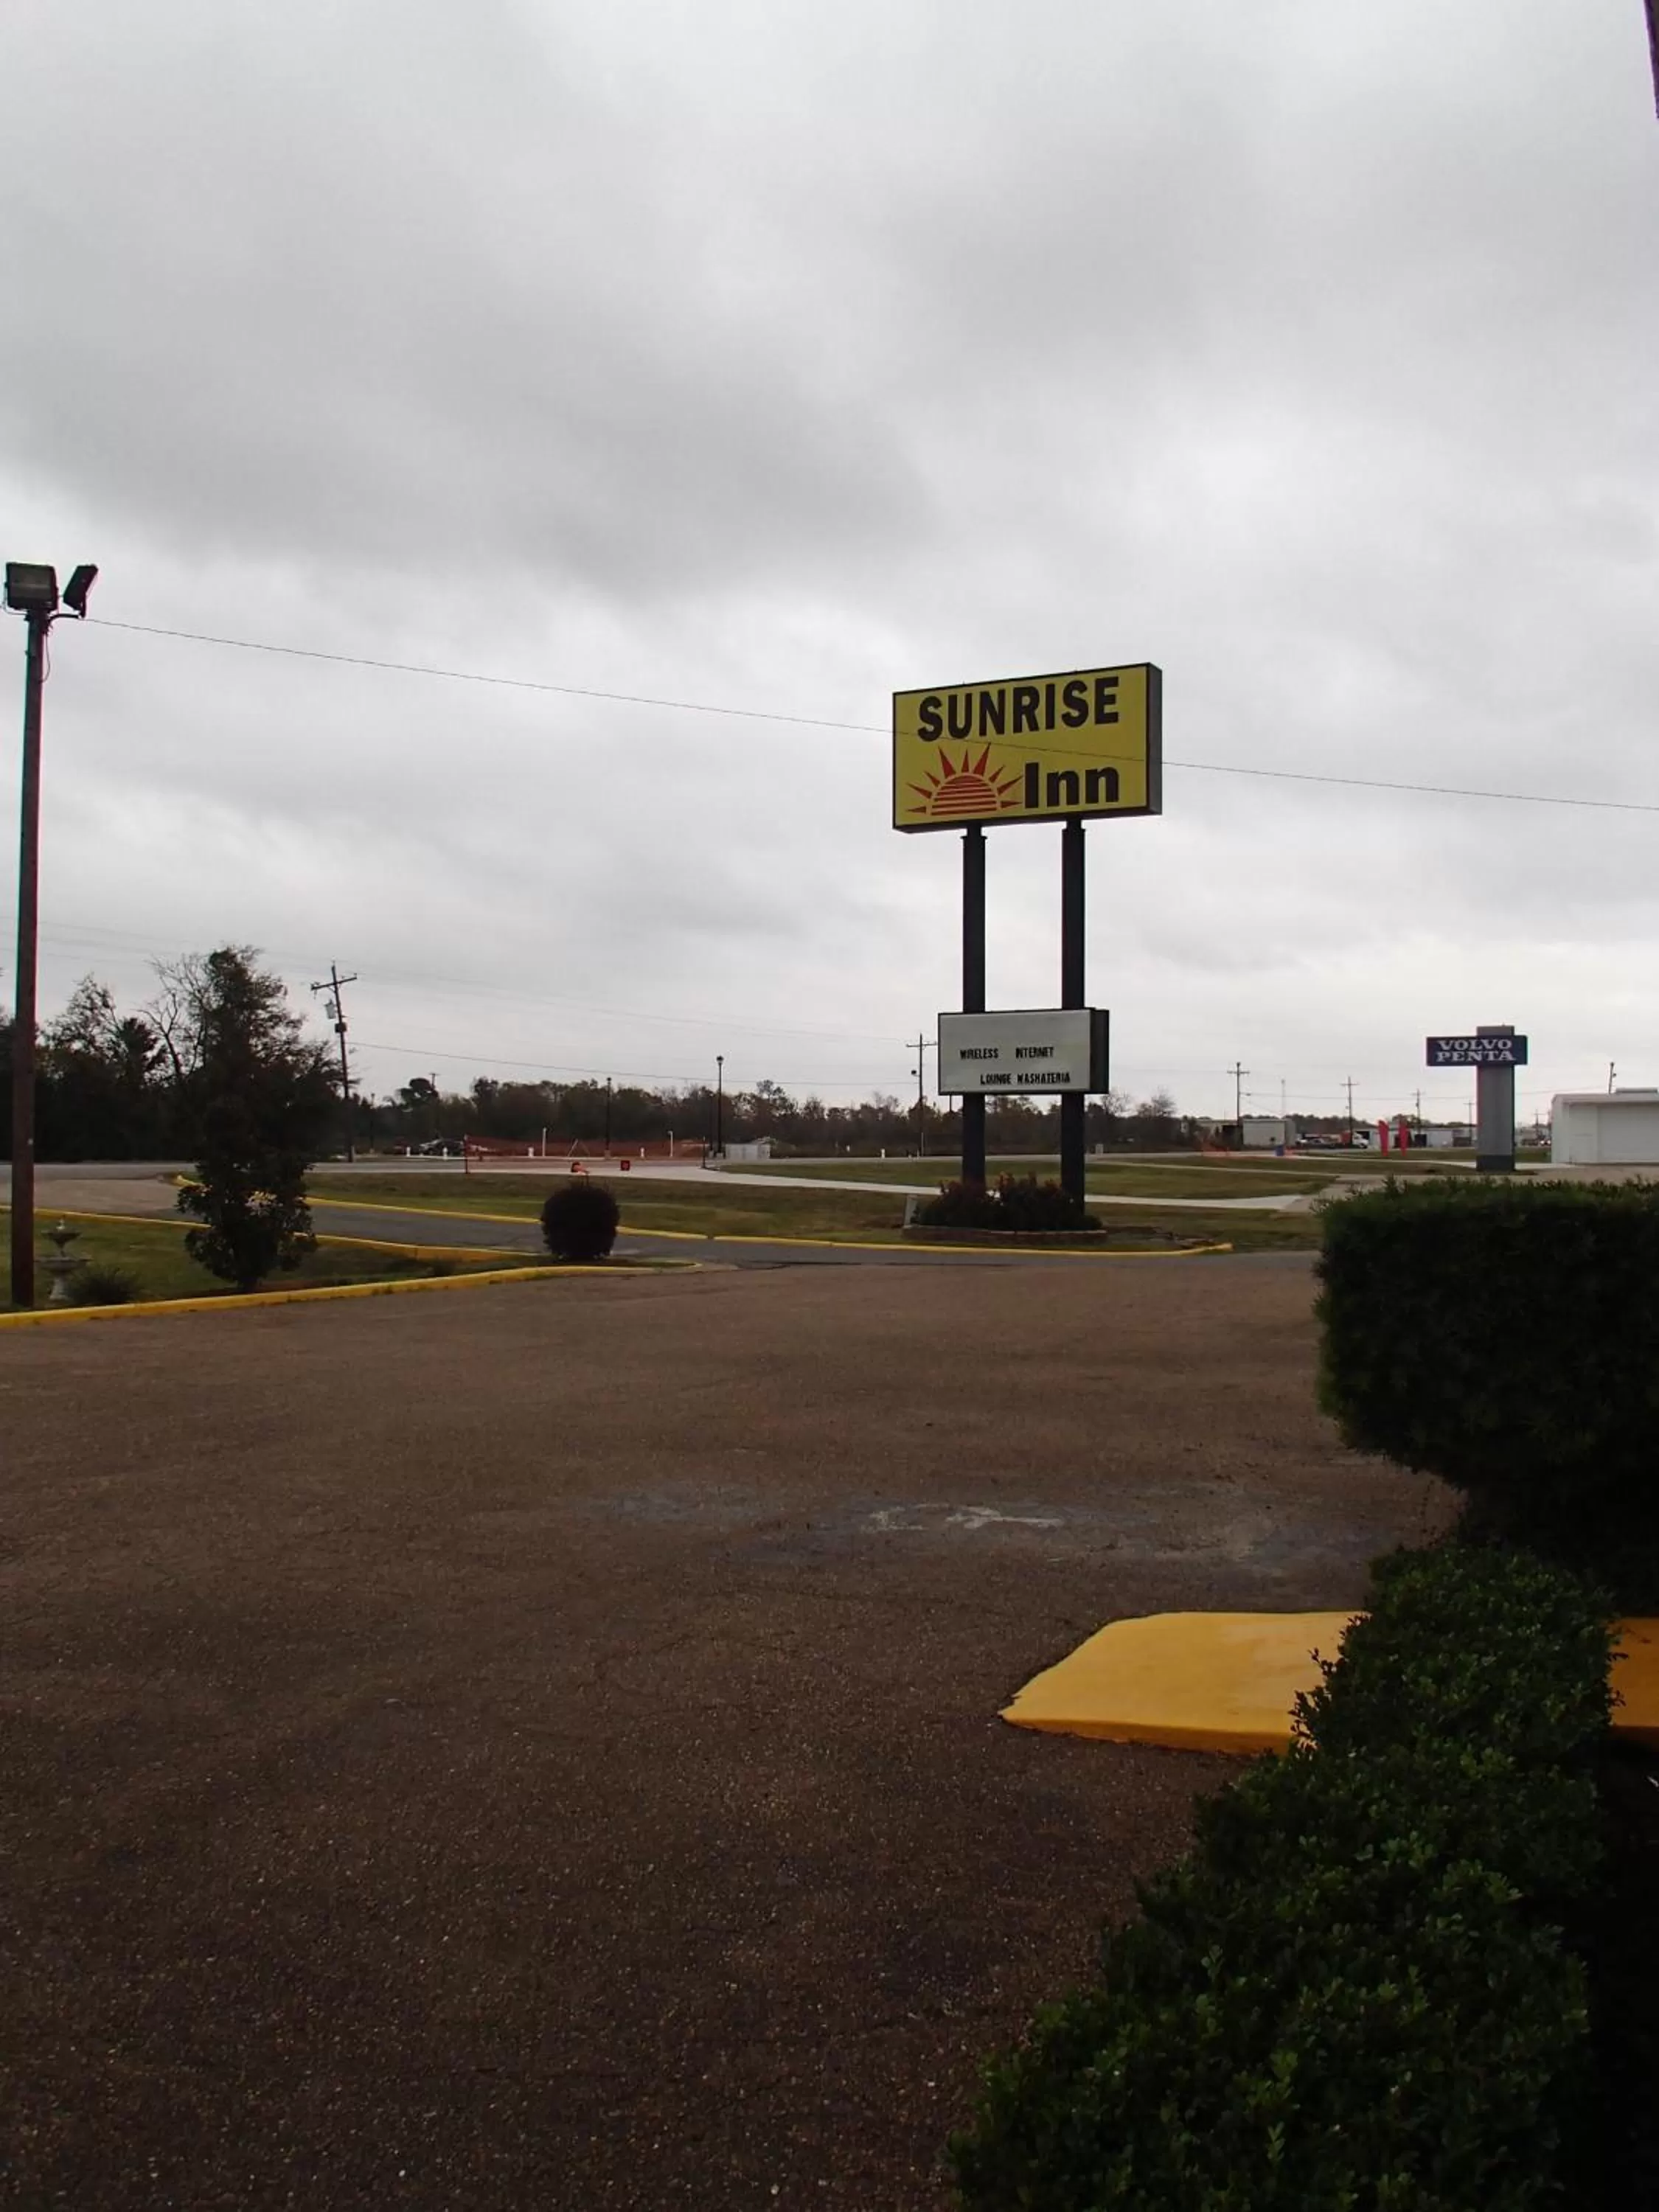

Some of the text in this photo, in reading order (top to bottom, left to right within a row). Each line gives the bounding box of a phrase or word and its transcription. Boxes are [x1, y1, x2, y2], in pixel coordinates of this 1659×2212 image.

[917, 676, 1119, 742] SUNRISE
[1024, 762, 1119, 809] Inn
[1438, 1039, 1512, 1050] VOLVO
[959, 1046, 1054, 1060] WIRELESS INTERNET
[1436, 1051, 1515, 1062] PENTA
[980, 1072, 1071, 1085] LOUNGE WASHATERIA
